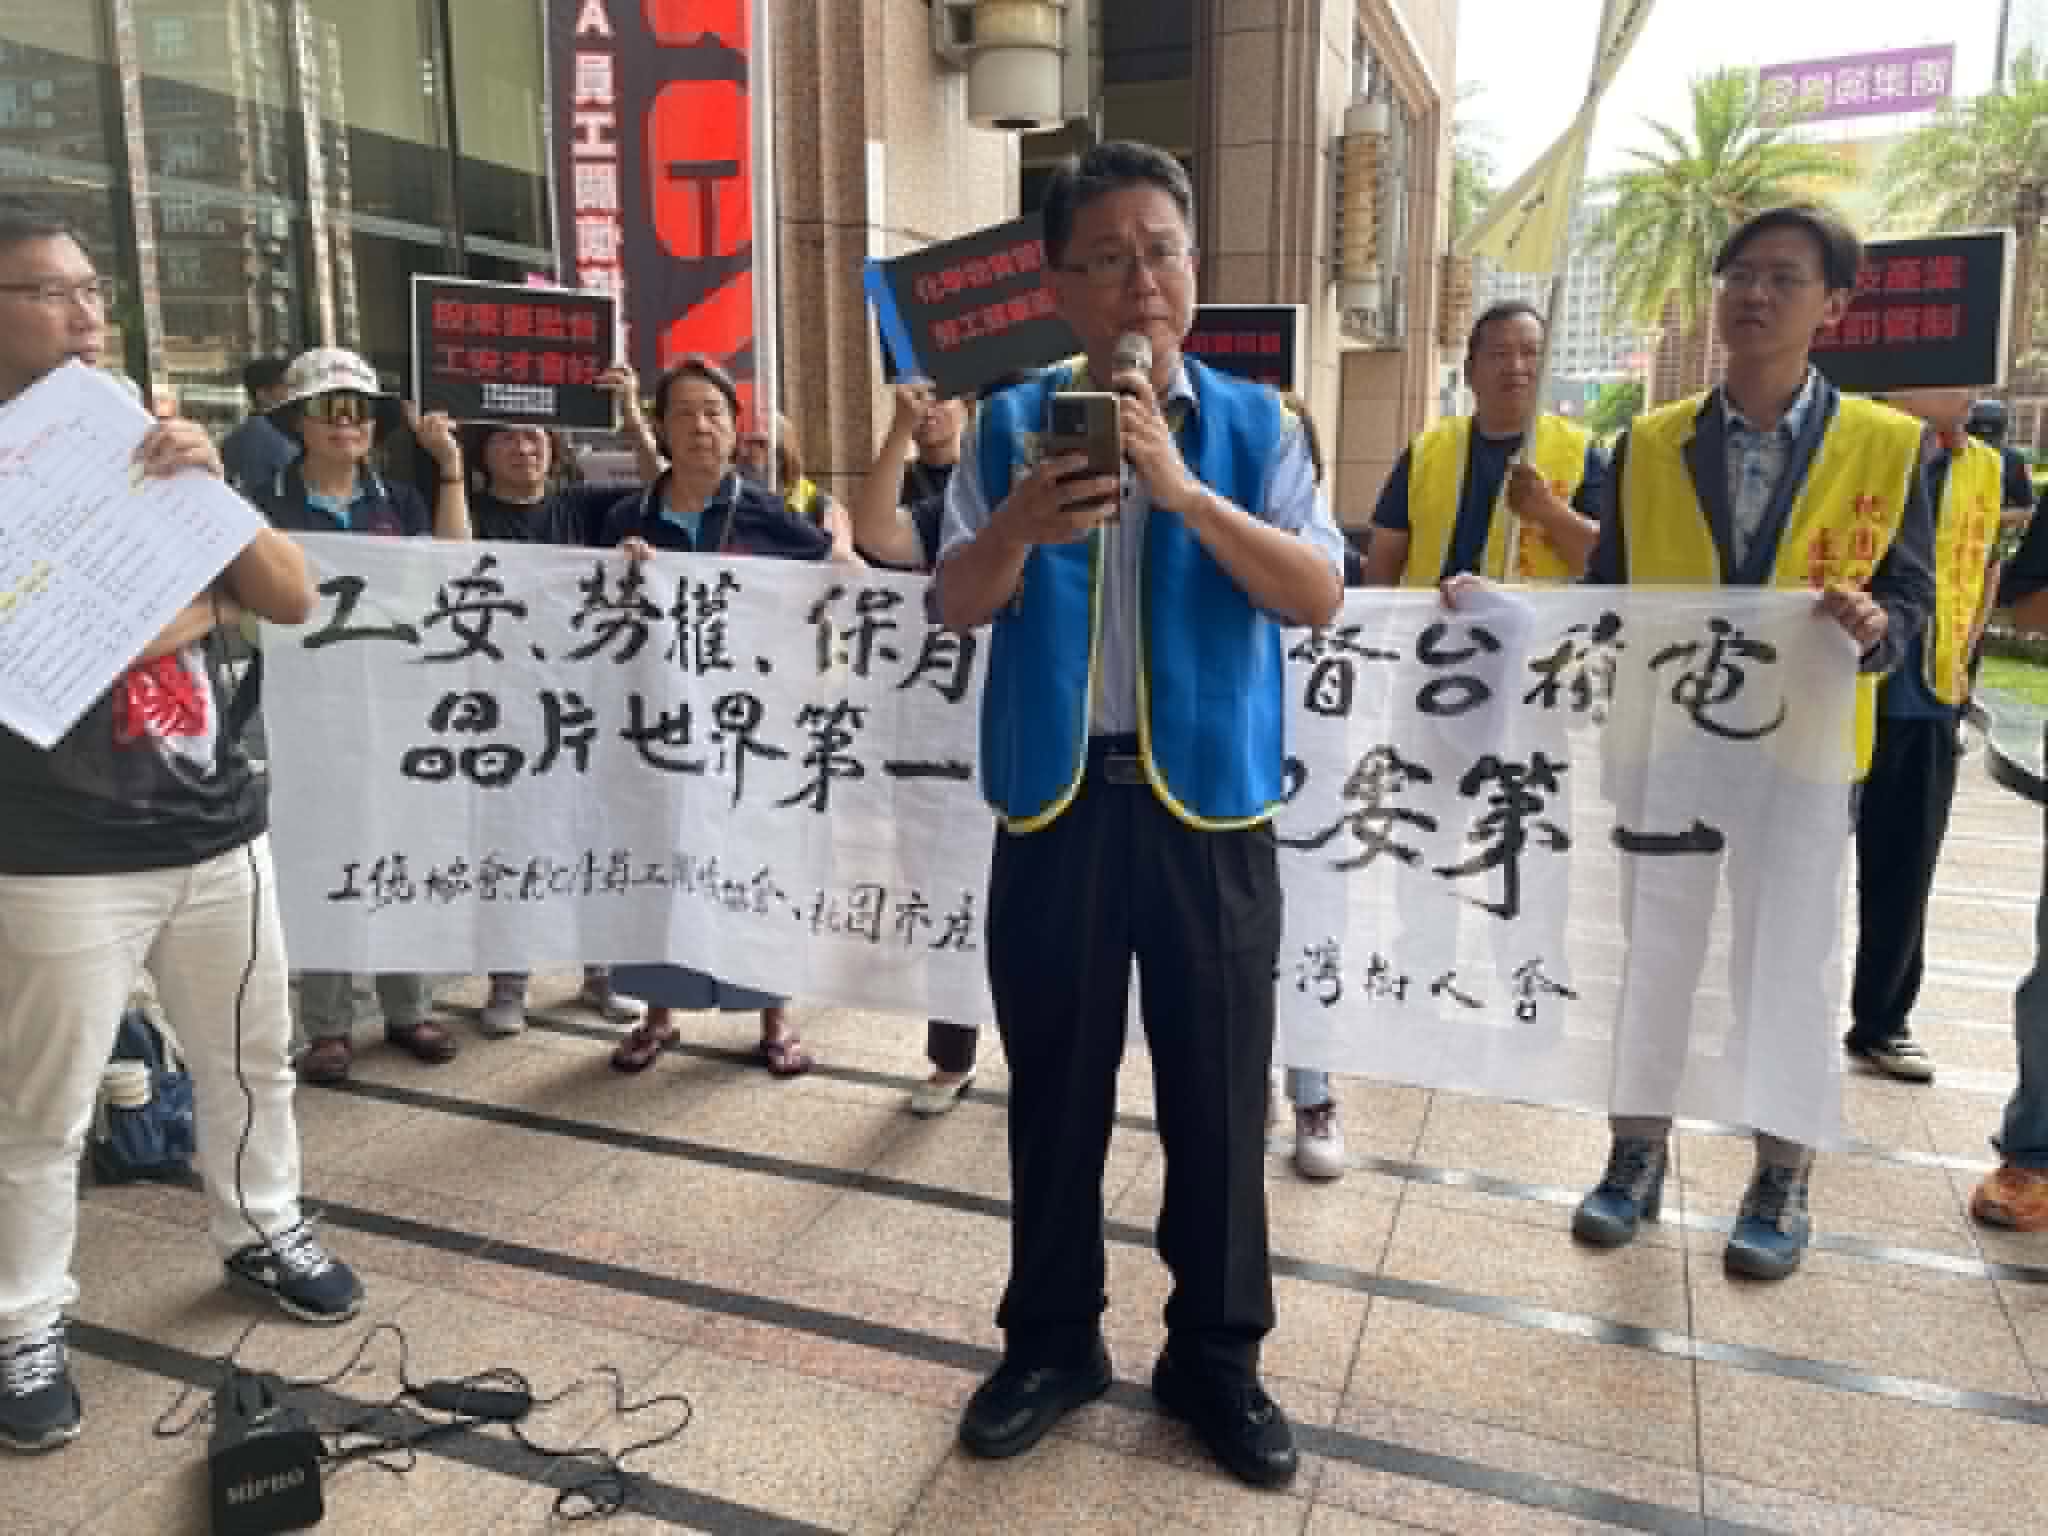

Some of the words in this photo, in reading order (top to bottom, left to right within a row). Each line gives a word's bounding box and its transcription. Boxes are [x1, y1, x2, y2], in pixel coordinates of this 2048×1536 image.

[400, 691, 971, 812] 晶片世界第一
